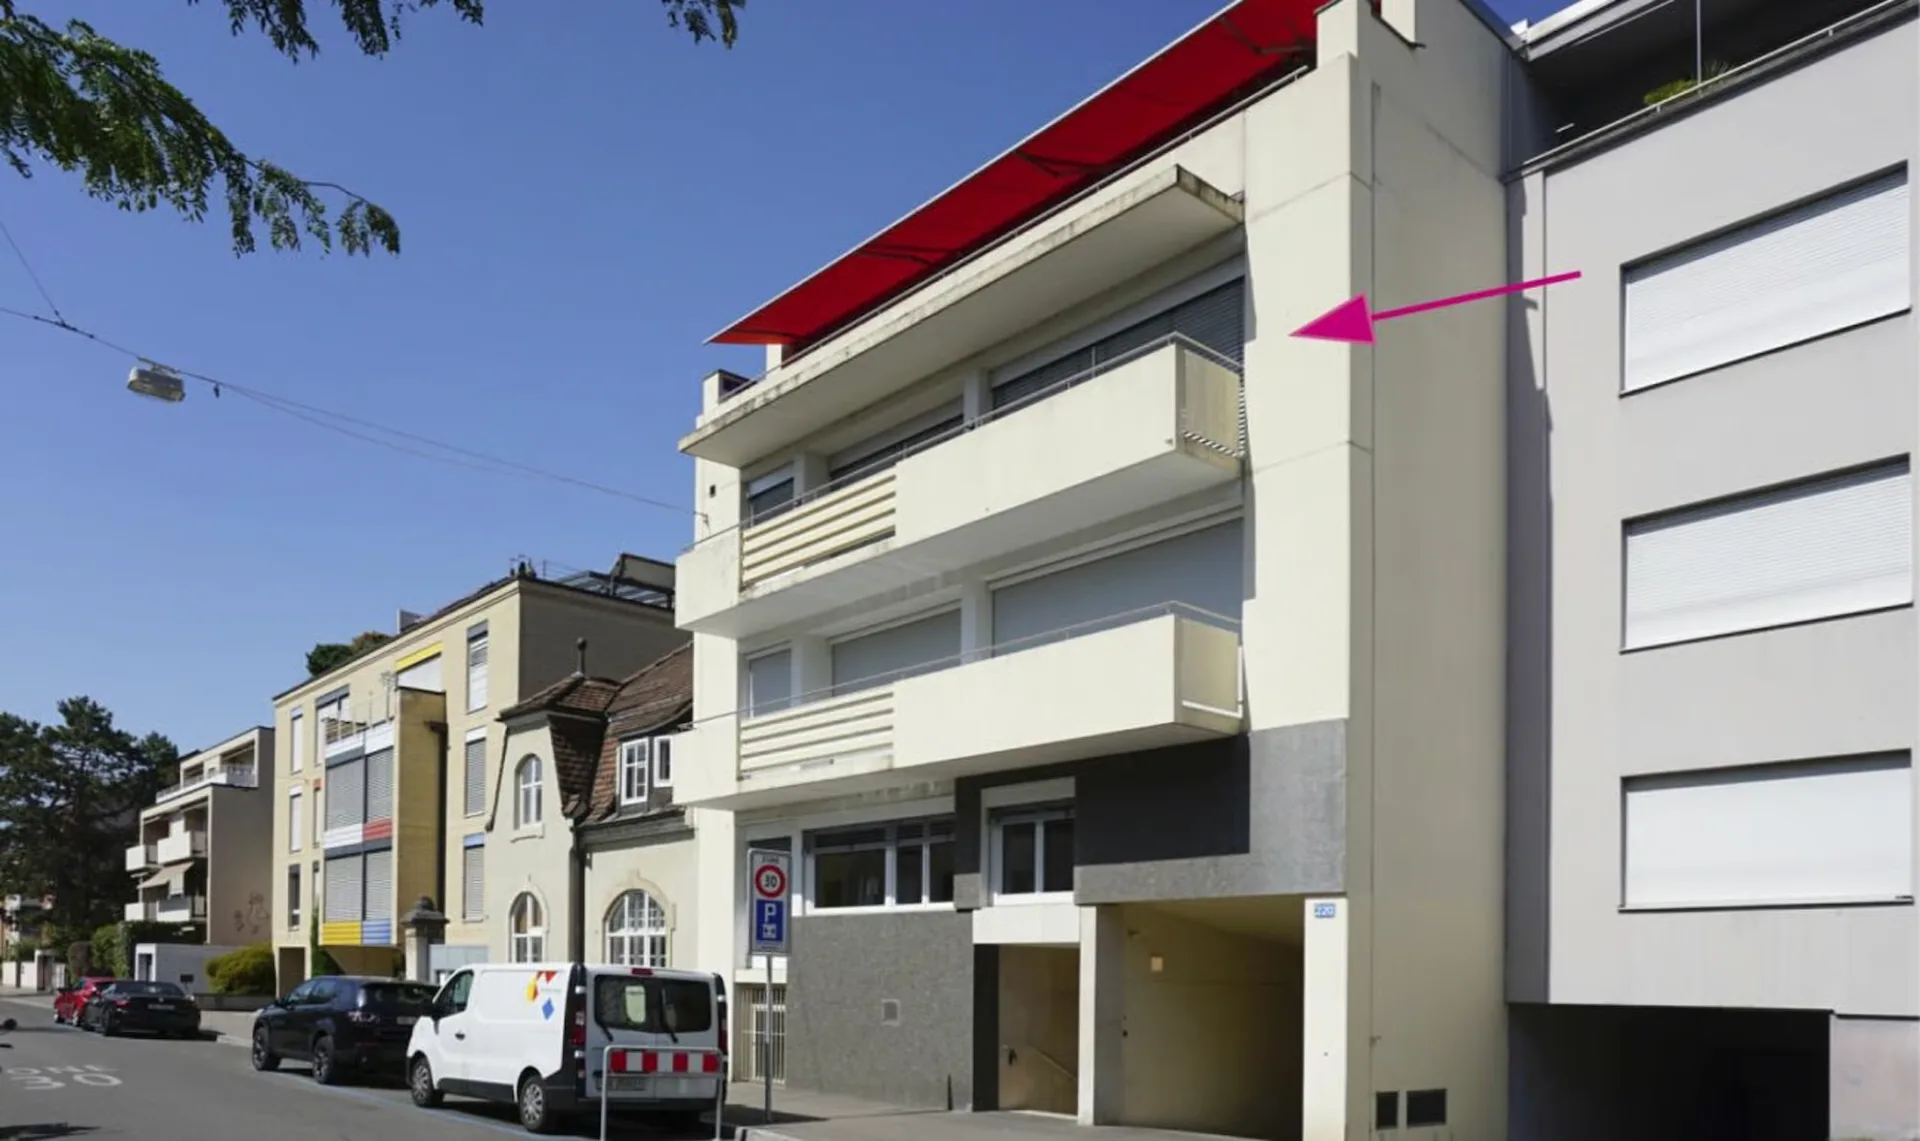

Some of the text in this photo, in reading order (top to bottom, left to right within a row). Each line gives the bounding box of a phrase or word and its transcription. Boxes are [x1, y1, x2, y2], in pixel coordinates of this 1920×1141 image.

[764, 874, 778, 889] 30
[764, 903, 777, 922] P
[10, 1073, 123, 1090] 30
